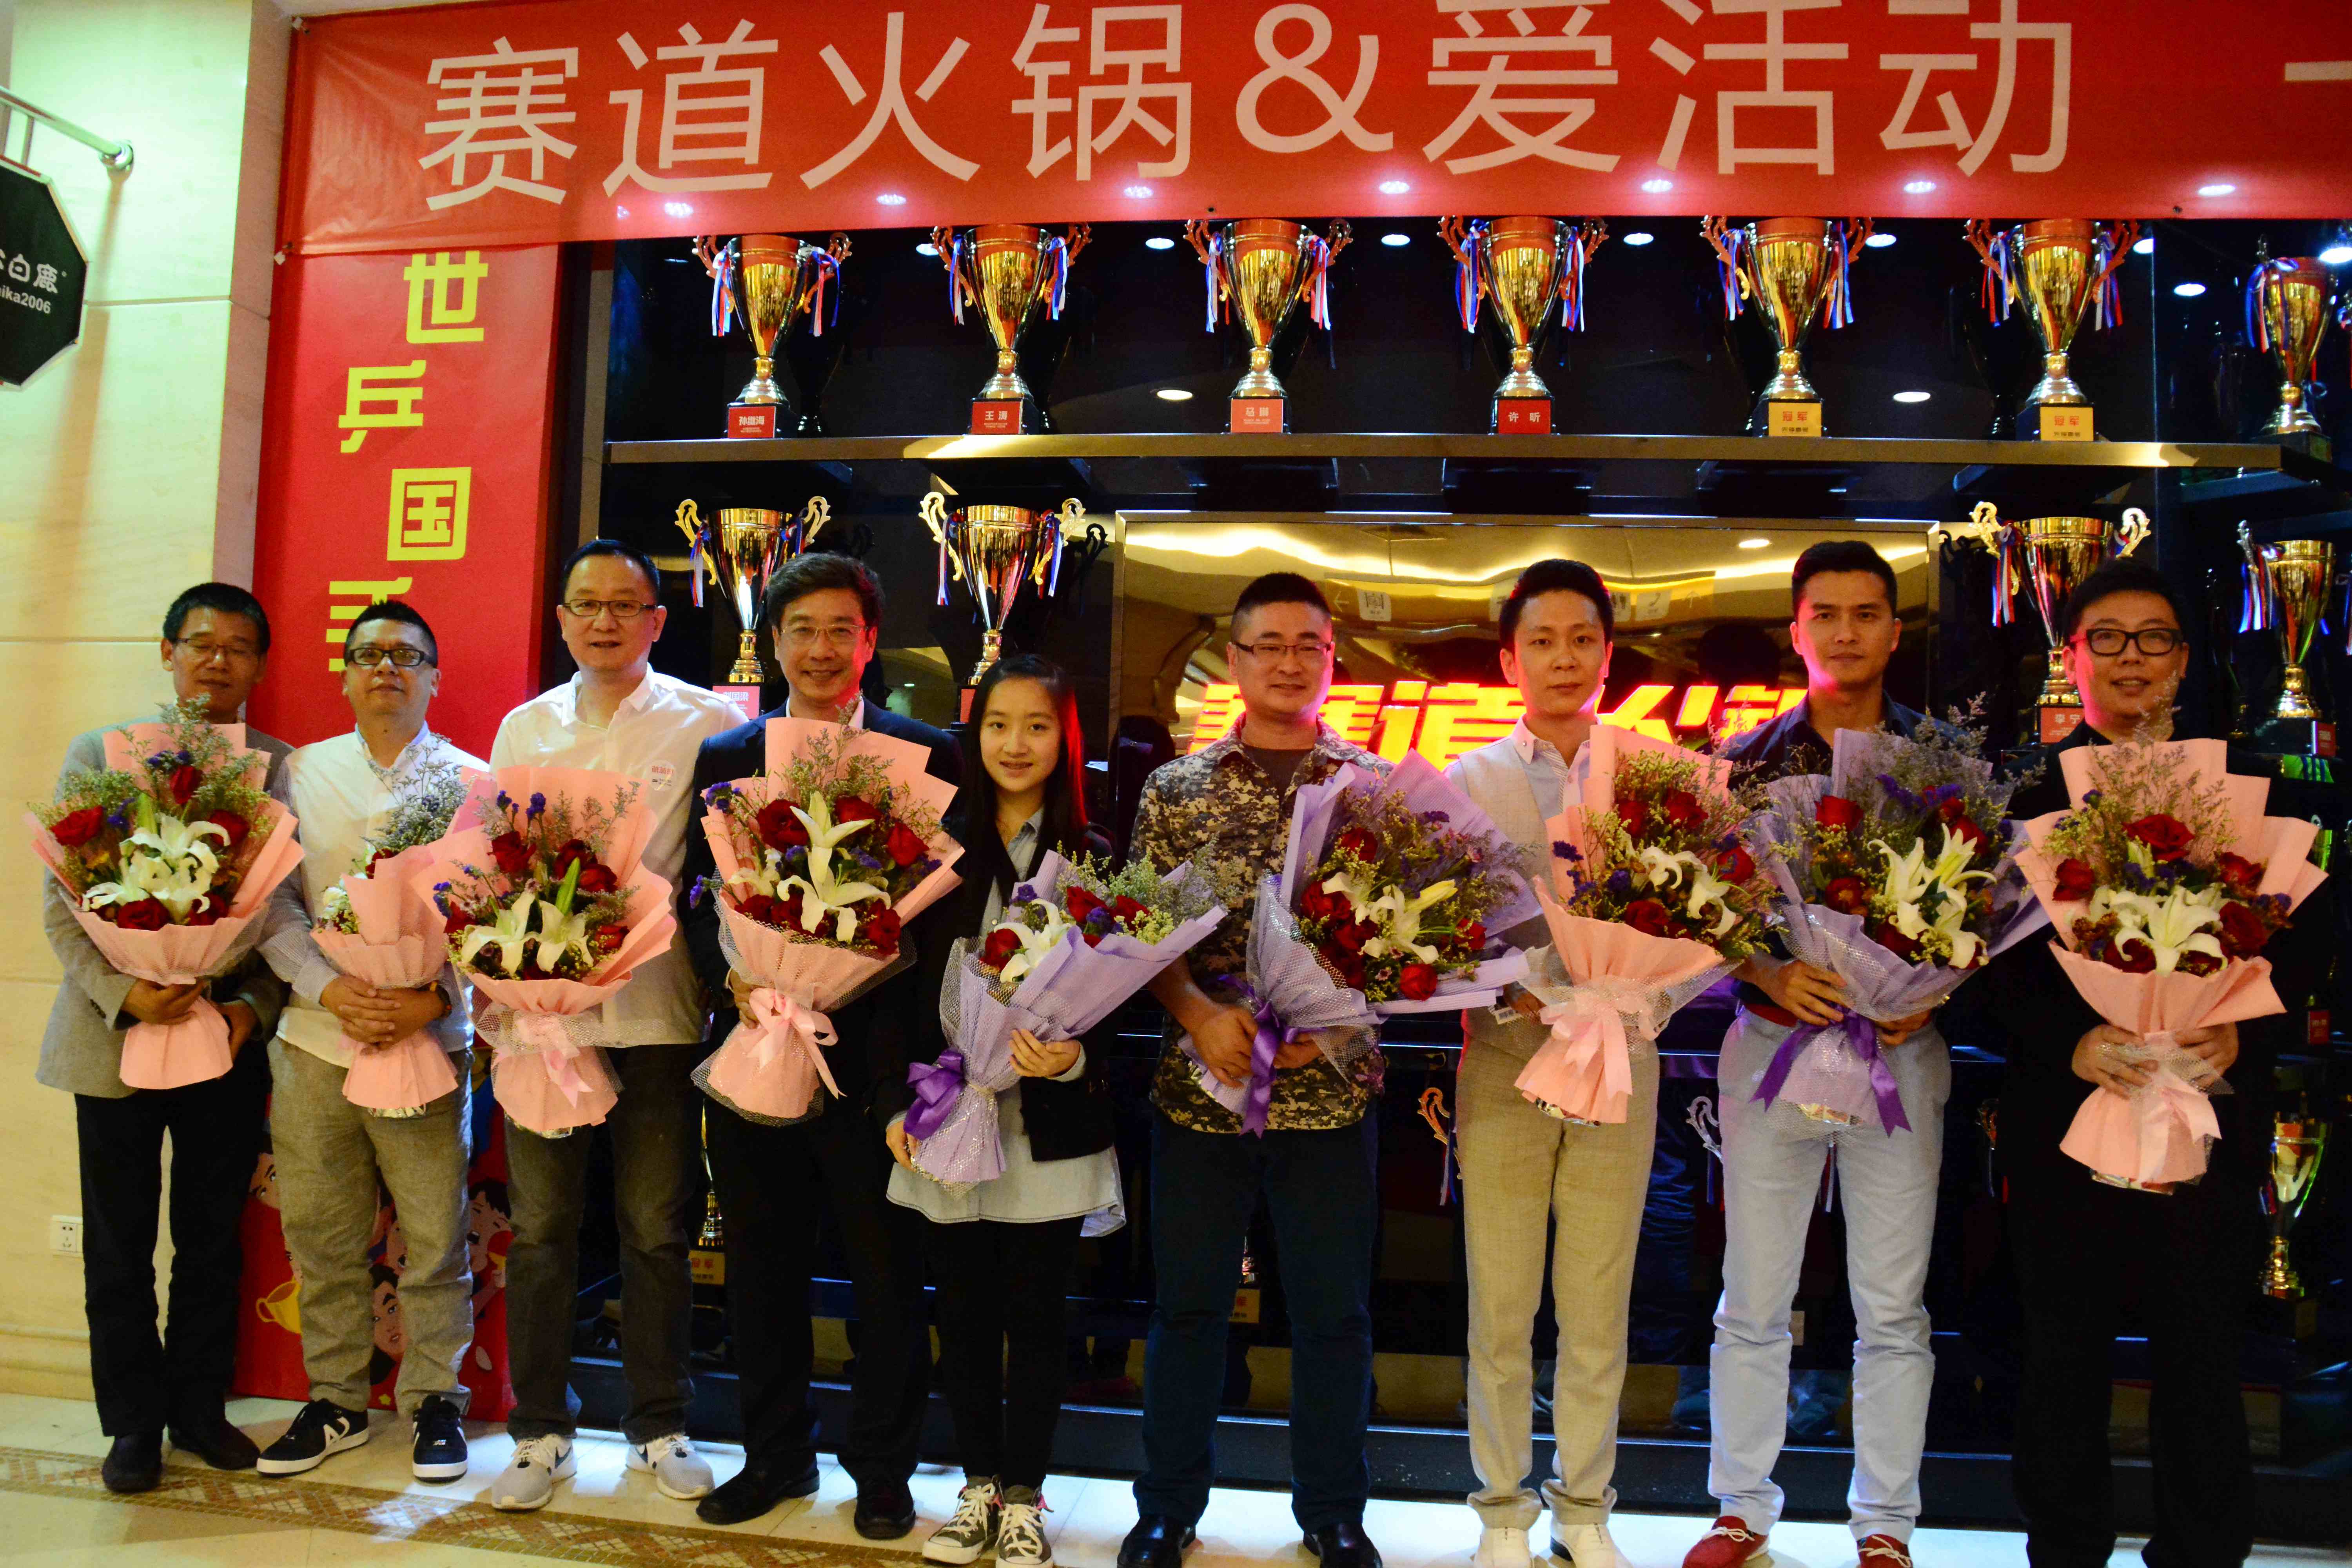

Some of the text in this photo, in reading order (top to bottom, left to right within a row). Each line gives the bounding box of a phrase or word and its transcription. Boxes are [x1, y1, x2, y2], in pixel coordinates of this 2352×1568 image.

[418, 0, 2071, 211] 赛道火锅&爱活动
[0, 285, 51, 314] ika2006
[1508, 412, 1540, 423] 许昕
[1782, 411, 1808, 422] 冠军
[2054, 416, 2080, 426] 冠军
[2055, 714, 2080, 724] 李宁
